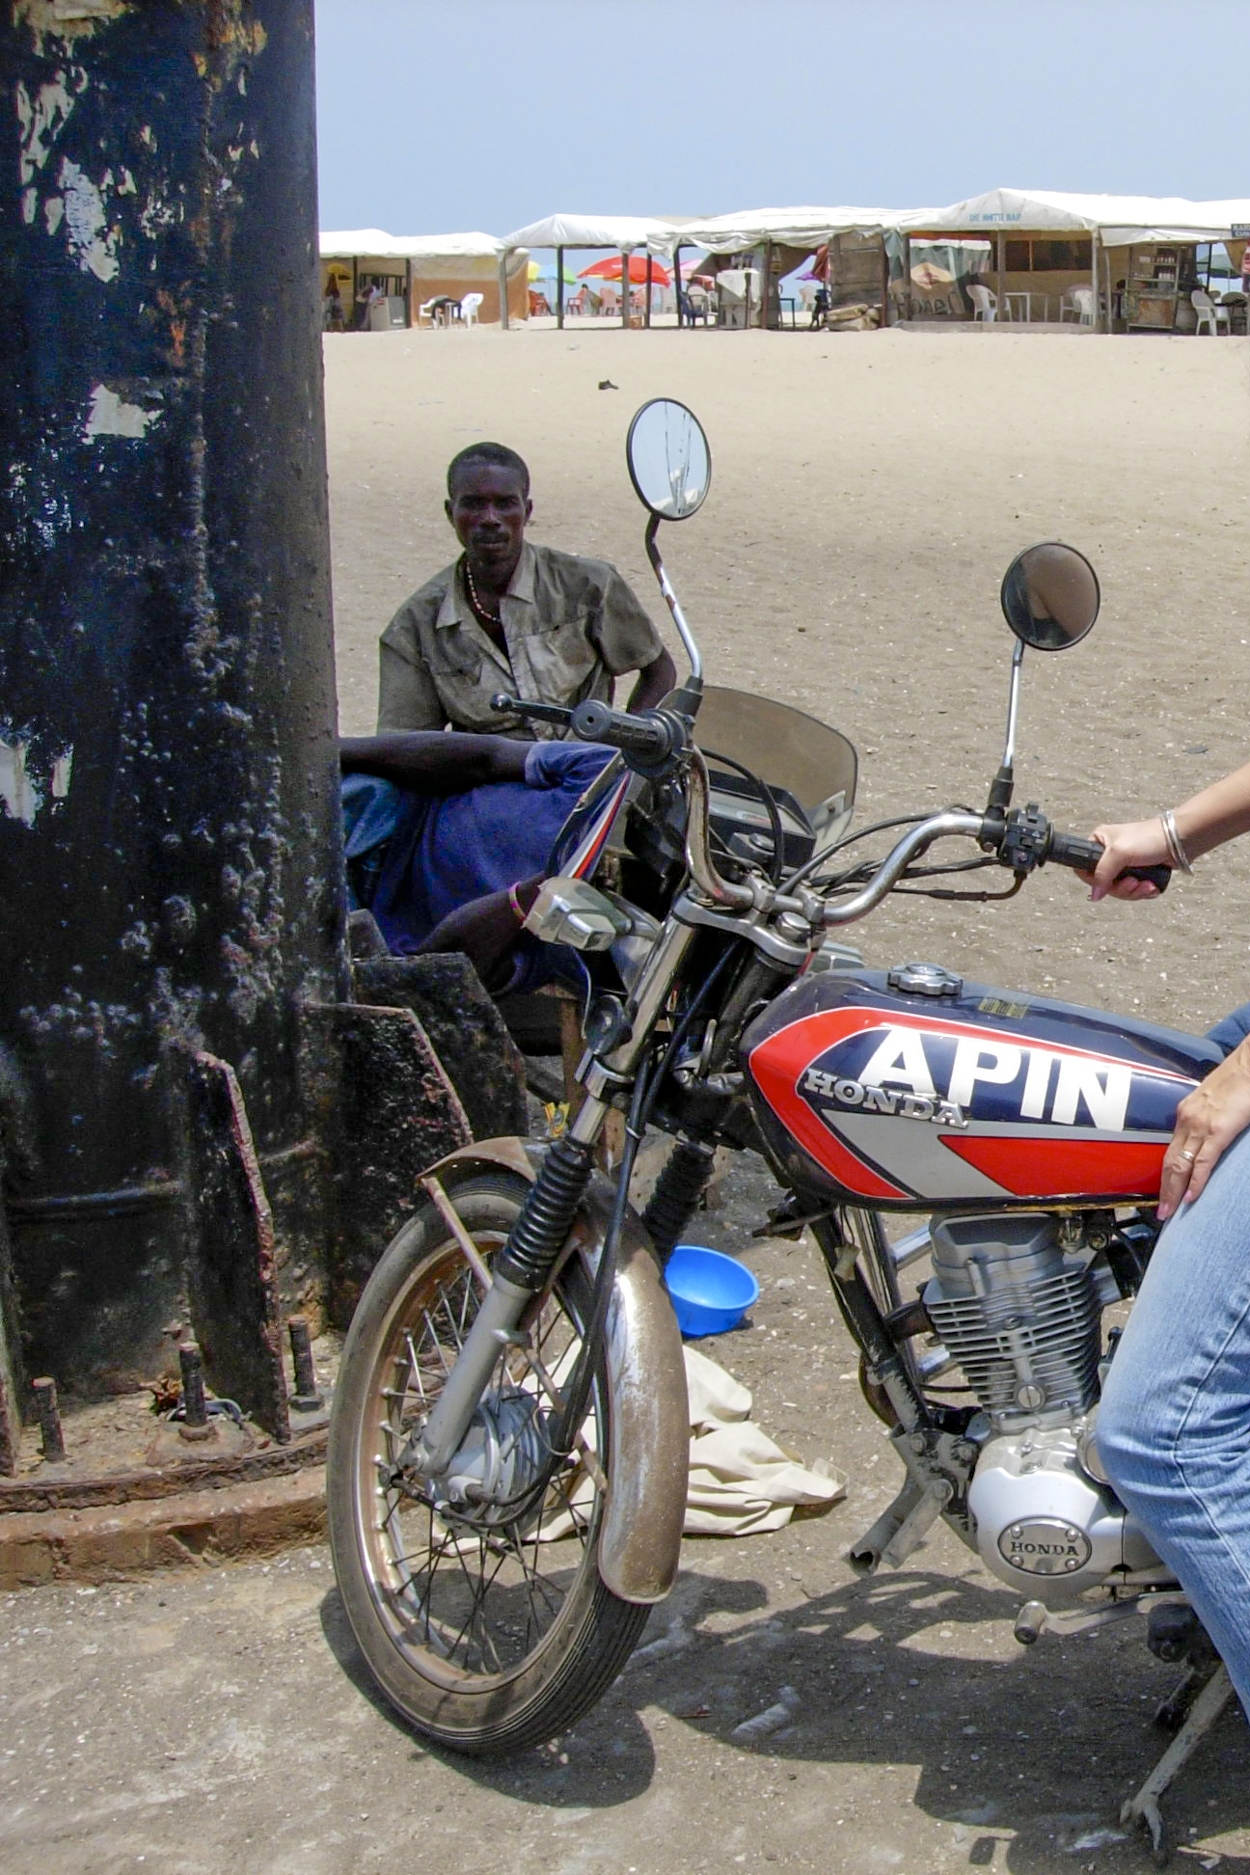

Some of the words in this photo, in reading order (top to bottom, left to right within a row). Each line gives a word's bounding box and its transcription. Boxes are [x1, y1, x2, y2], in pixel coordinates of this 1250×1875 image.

[804, 1067, 969, 1129] HONDA
[857, 1028, 1132, 1132] APIN
[1010, 1541, 1079, 1557] HONDA
